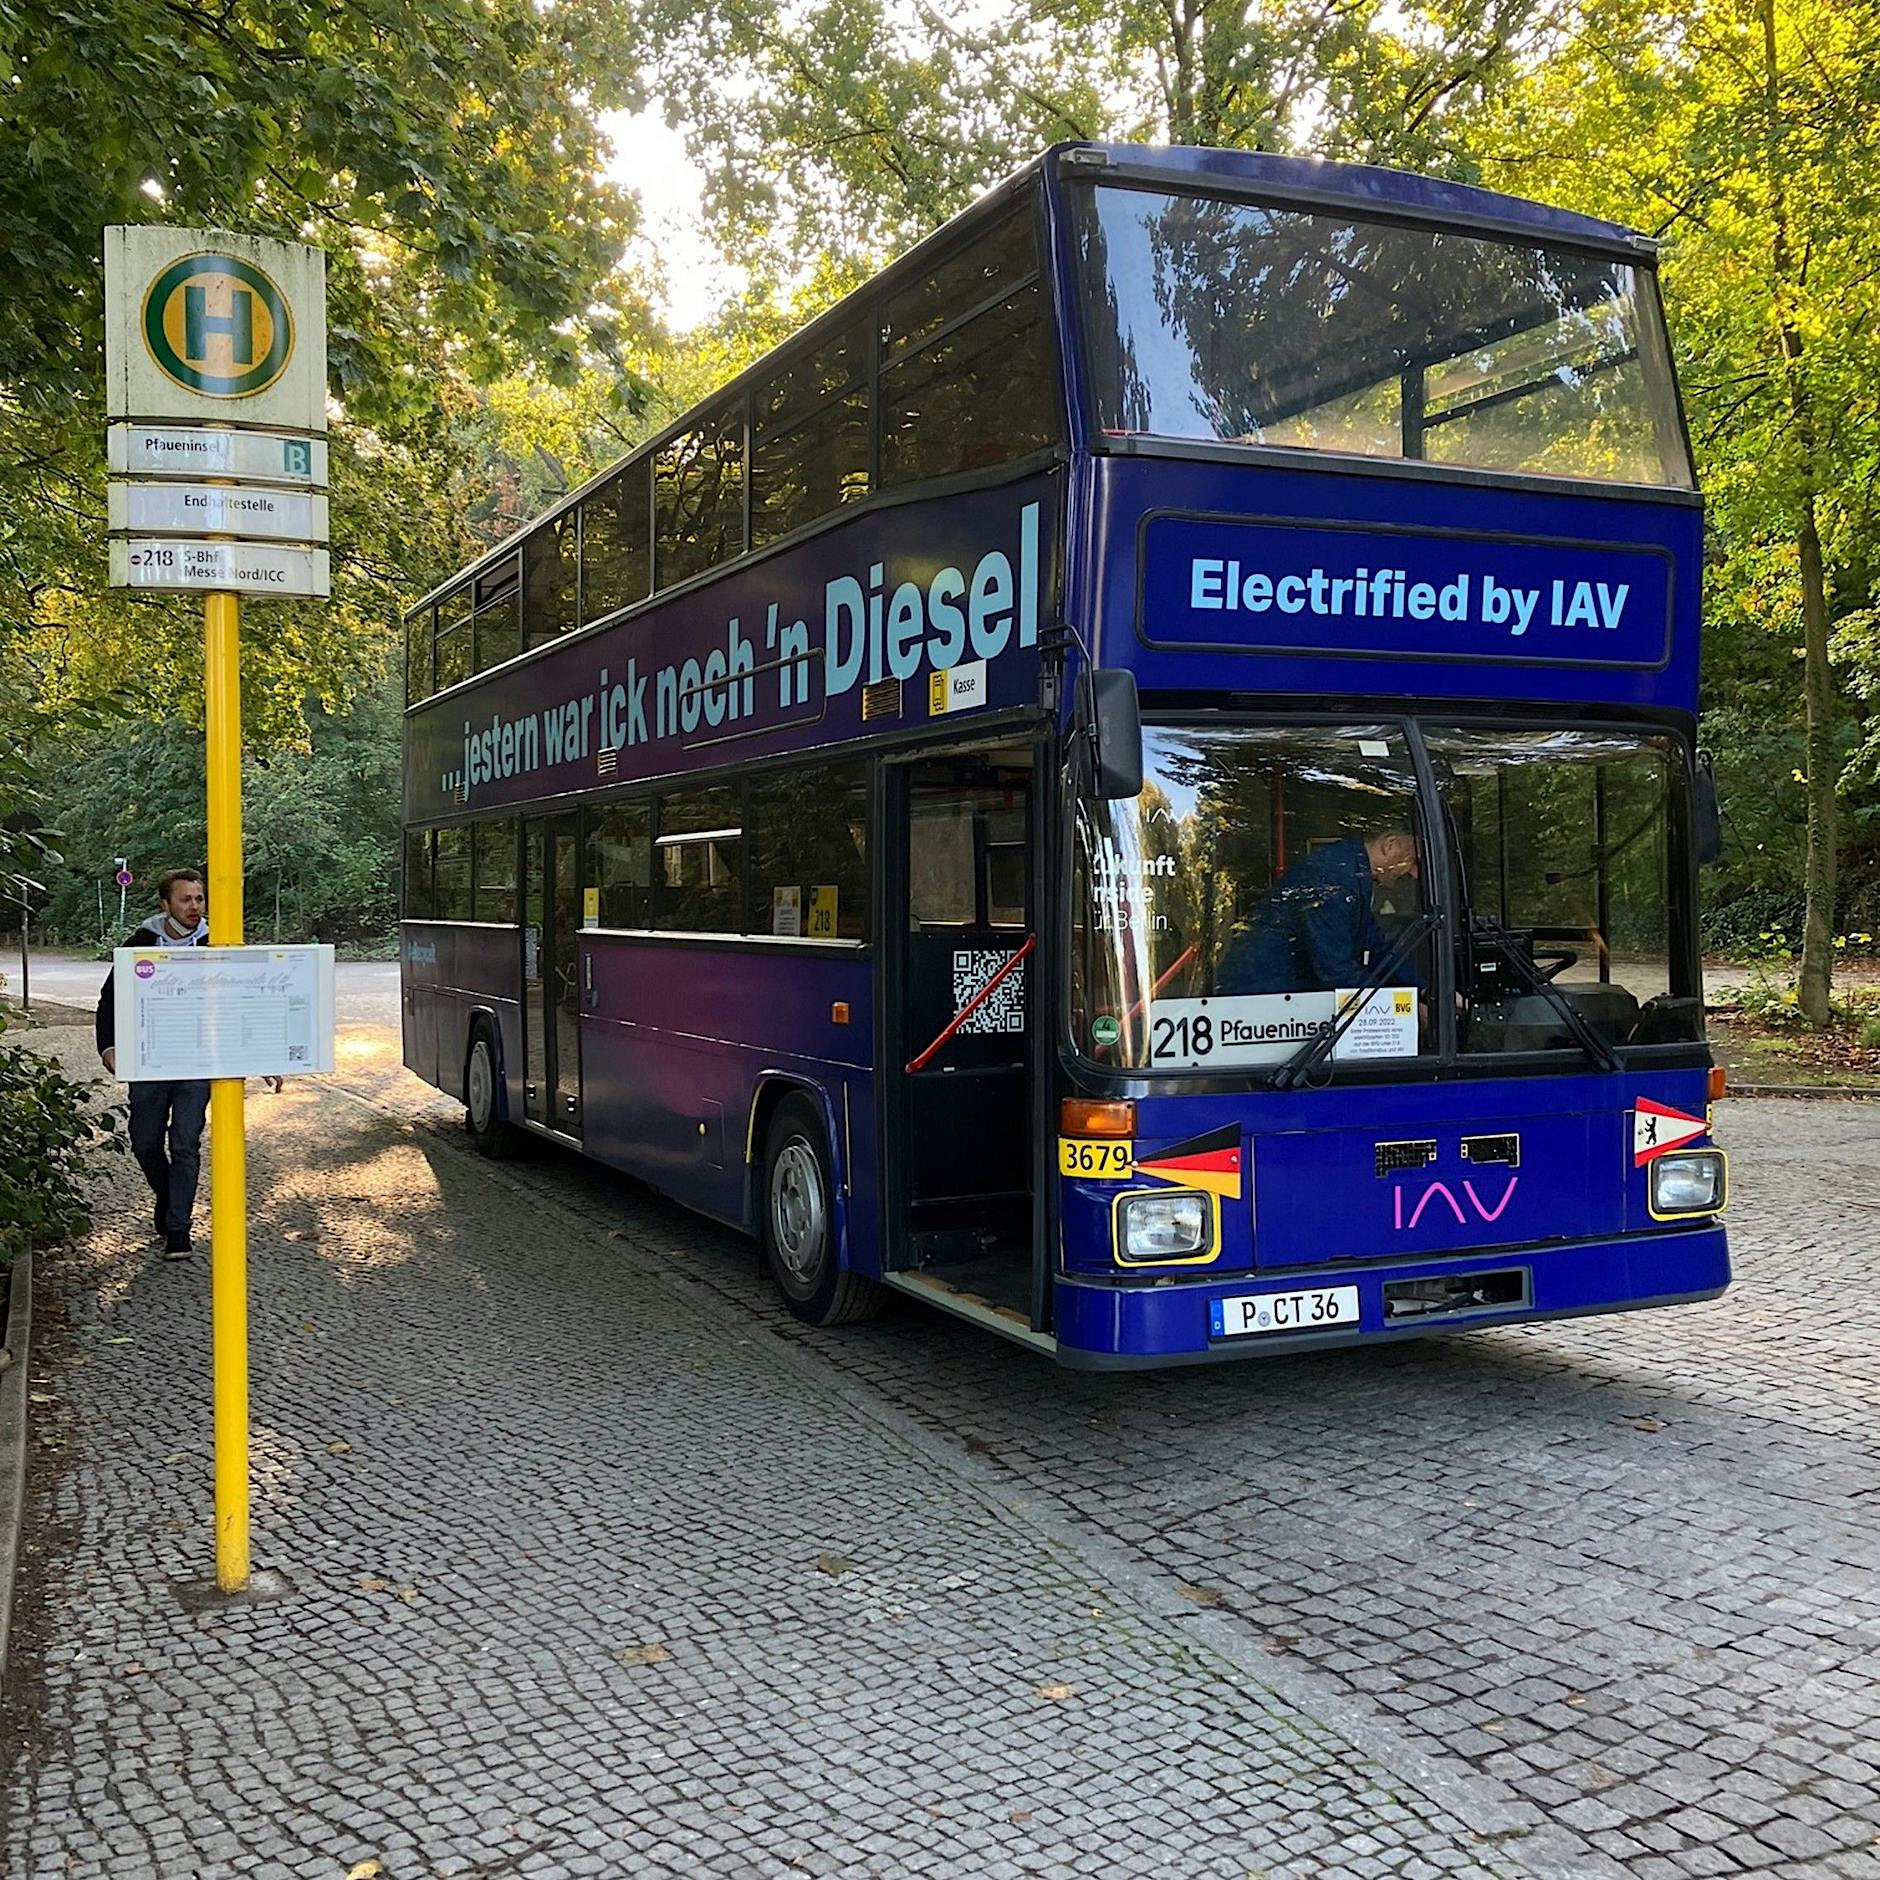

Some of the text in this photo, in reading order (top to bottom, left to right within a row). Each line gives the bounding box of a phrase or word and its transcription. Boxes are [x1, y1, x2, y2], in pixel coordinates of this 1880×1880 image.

[185, 285, 253, 365] H
[144, 437, 307, 475] Pfaueninsel B
[184, 494, 275, 513] Endhaltestelle
[144, 550, 220, 567] 218 S-Bhf
[1191, 558, 1629, 635] Electrified by IAV
[543, 694, 596, 766] war
[599, 657, 649, 750] ick
[656, 618, 755, 739] noch
[825, 502, 1039, 697] Diesel
[953, 677, 976, 695] Kasse
[814, 909, 831, 932] 218
[1364, 1003, 1411, 1015] IAV BVG
[1152, 1015, 1214, 1059] 218
[1066, 1143, 1128, 1171] 3679
[1395, 1177, 1518, 1229] IAV
[1241, 1293, 1339, 1328] P CT 36
